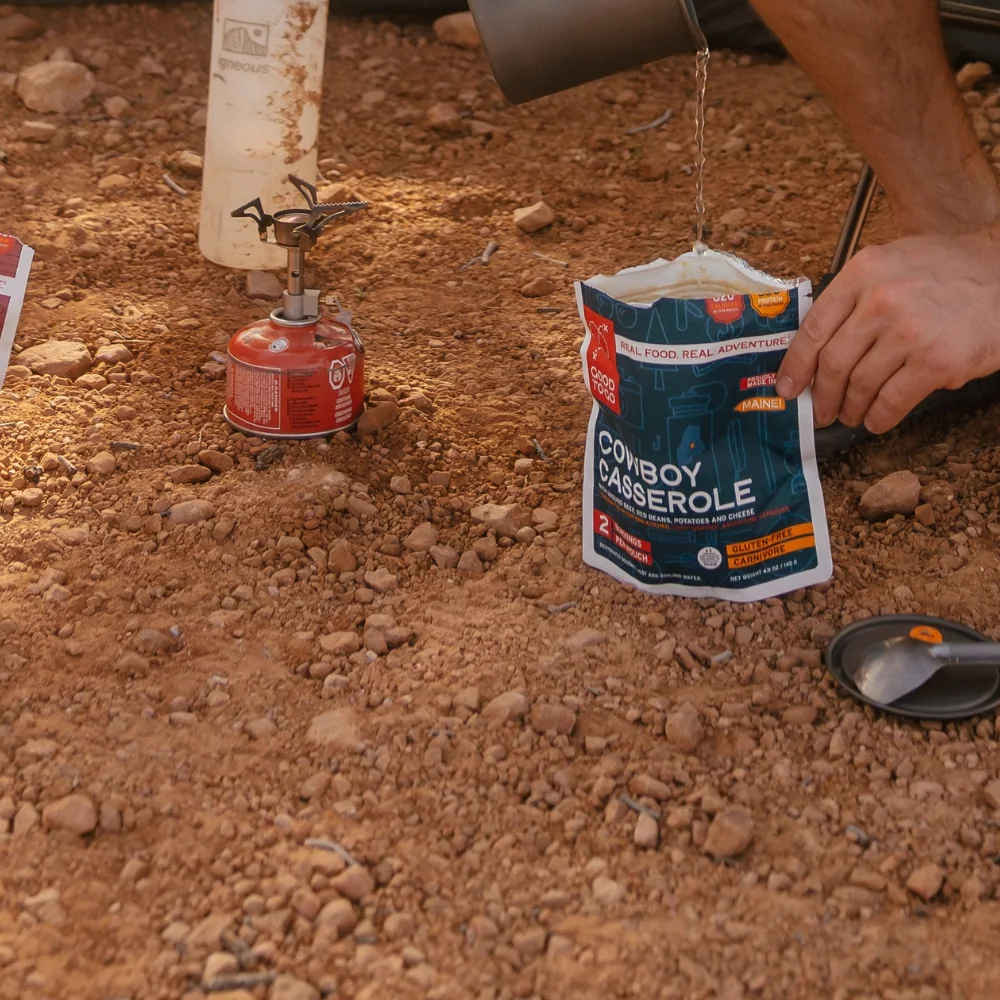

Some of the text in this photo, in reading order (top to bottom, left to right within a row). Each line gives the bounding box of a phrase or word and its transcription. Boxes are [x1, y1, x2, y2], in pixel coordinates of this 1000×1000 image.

[757, 296, 783, 304] PROTEIN
[620, 341, 642, 356] REAL
[645, 348, 679, 359] FOOD.
[683, 348, 714, 359] REAL
[590, 366, 615, 391] GOOD
[747, 372, 776, 382] PROUDLY
[747, 378, 767, 388] MADE
[742, 399, 782, 411] MAINE!
[598, 430, 702, 487] COWBOY
[599, 458, 756, 514] CASSEROLE
[599, 514, 609, 535] 2
[674, 517, 710, 525] POTATOES
[711, 515, 727, 524] AND
[728, 508, 755, 520] CHEESE
[732, 528, 793, 553] GLUTEN-FREE
[733, 545, 786, 566] CARNIVORE
[730, 575, 742, 583] NET
[742, 570, 762, 580] WEIGHT
